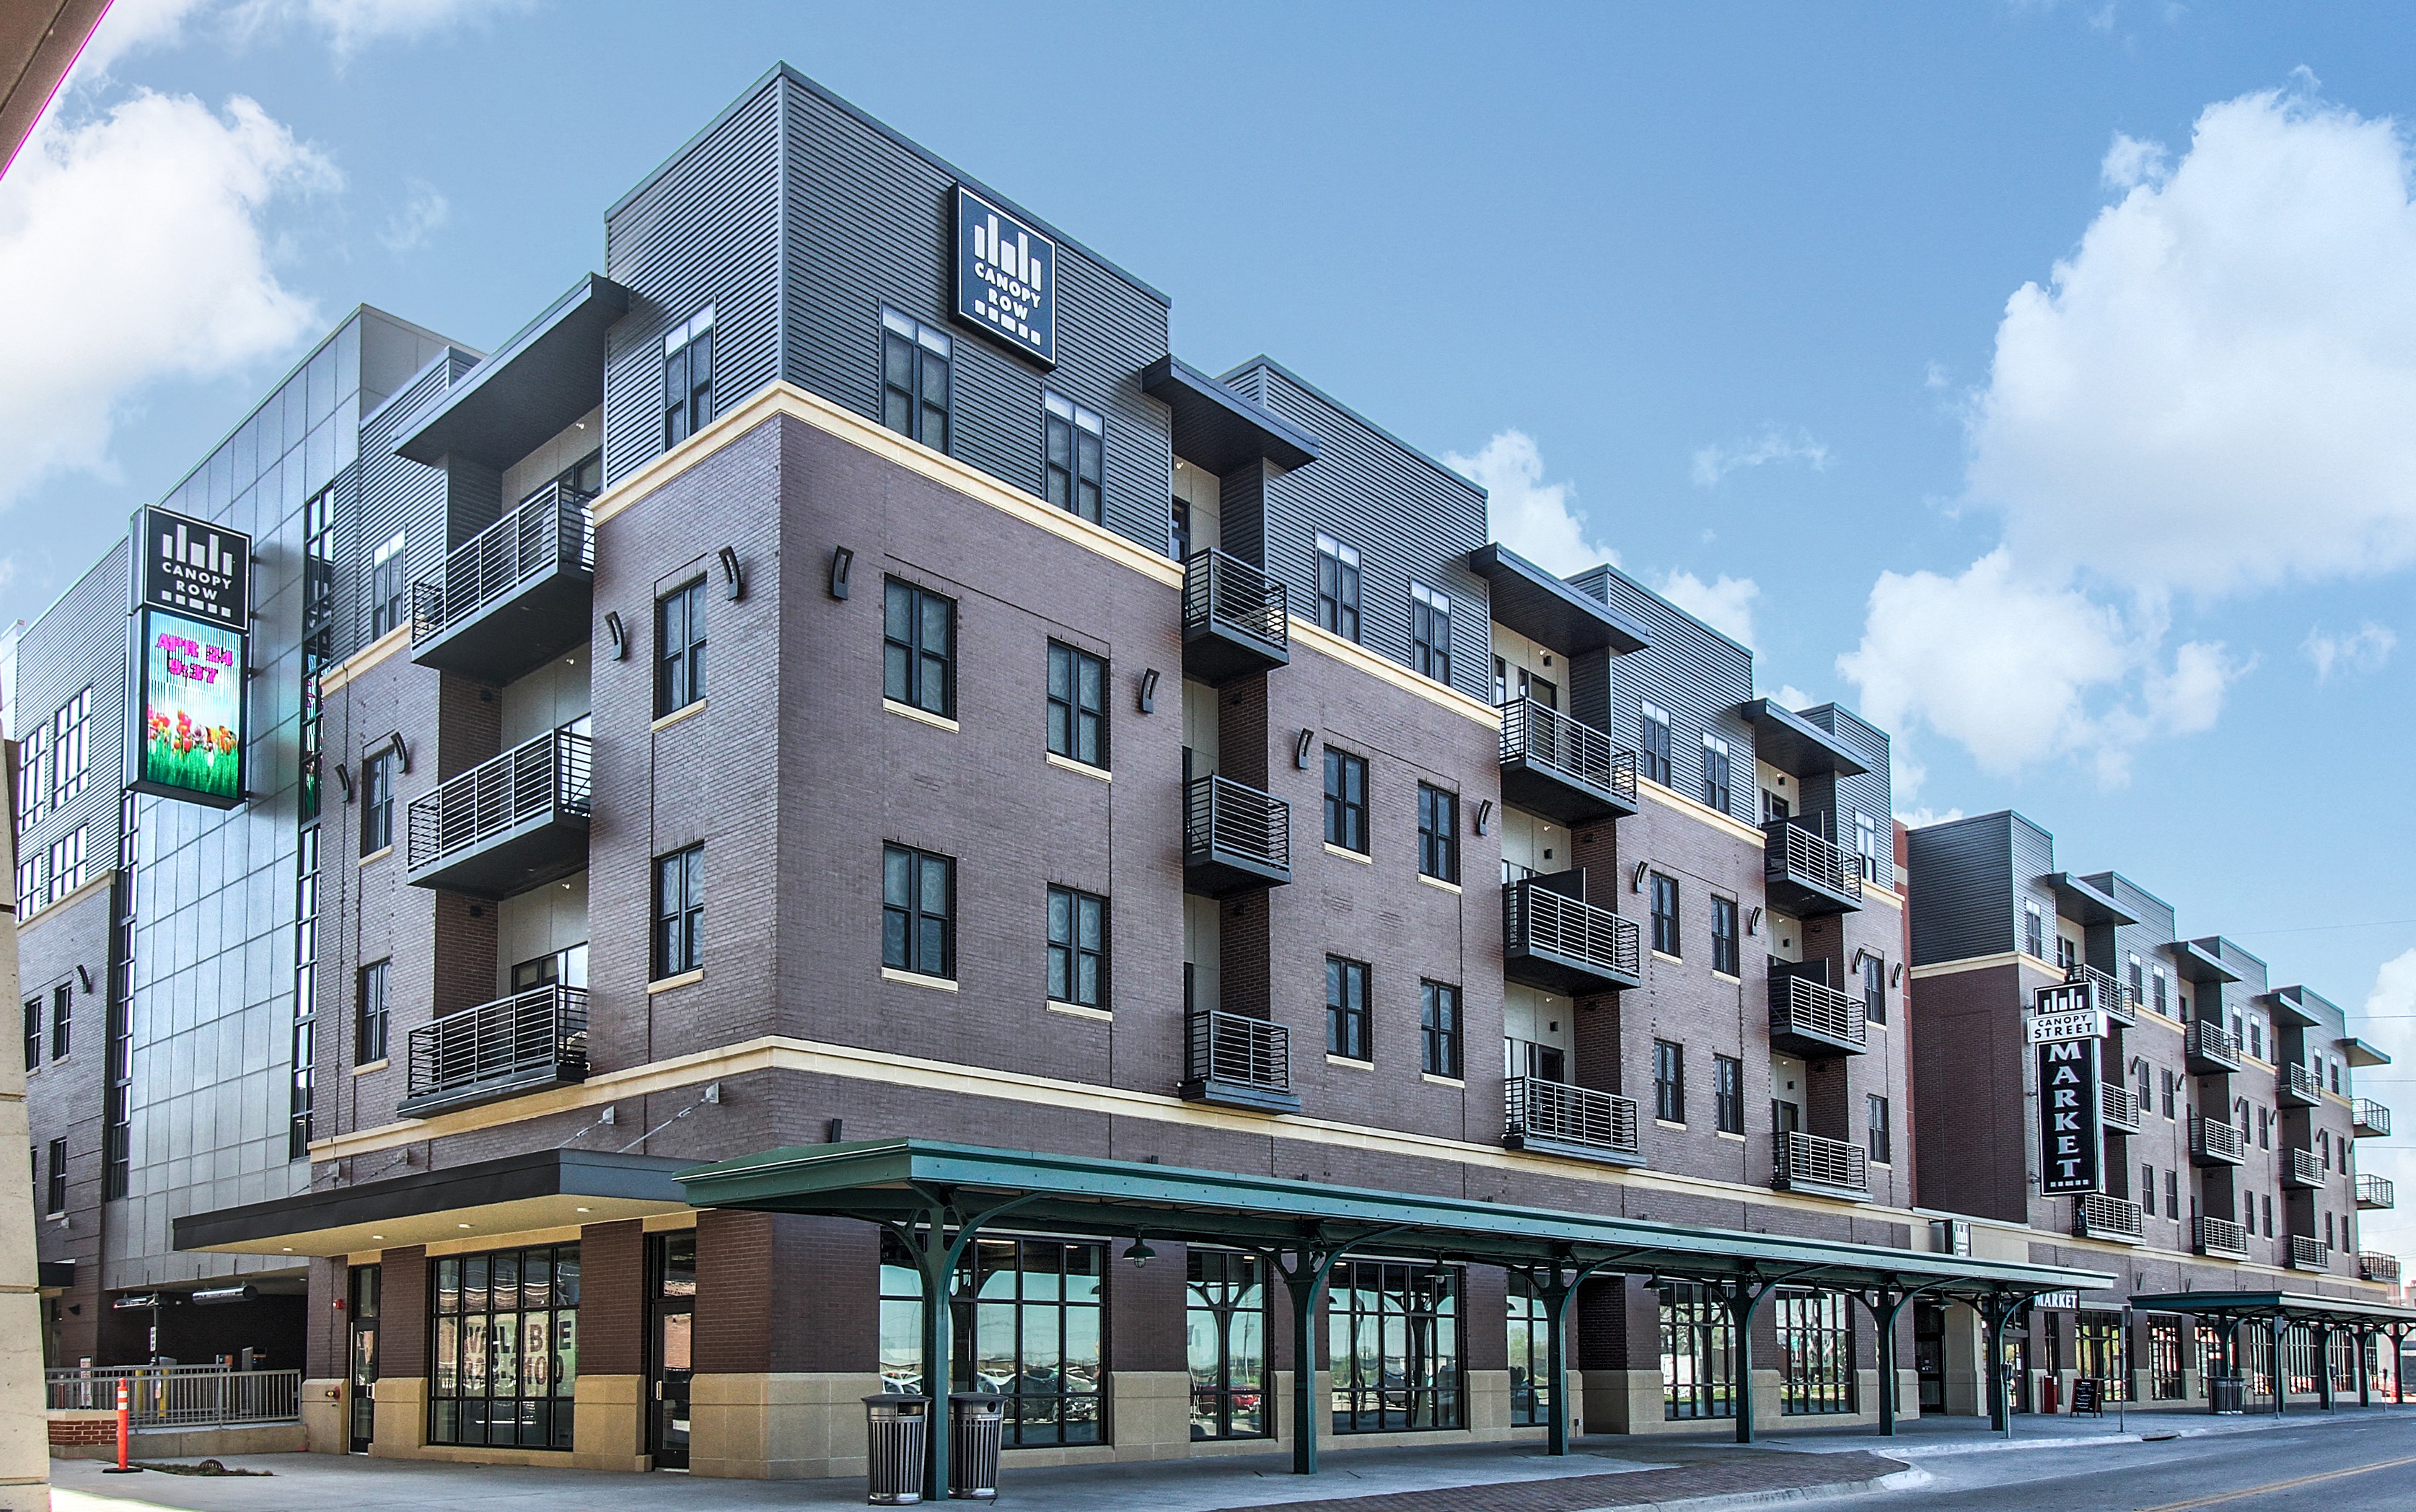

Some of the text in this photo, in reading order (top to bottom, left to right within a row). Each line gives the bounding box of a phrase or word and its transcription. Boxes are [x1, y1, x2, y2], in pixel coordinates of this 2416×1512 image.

[975, 262, 1041, 308] CANOPY
[988, 288, 1028, 320] ROW
[162, 562, 232, 589] CANOPY
[176, 580, 218, 600] ROW
[157, 633, 233, 666] APR 24
[2034, 1022, 2092, 1039] STREET
[2038, 1014, 2087, 1027] CANOPY
[2048, 1042, 2082, 1178] MARKET
[2034, 1293, 2077, 1309] MARKET
